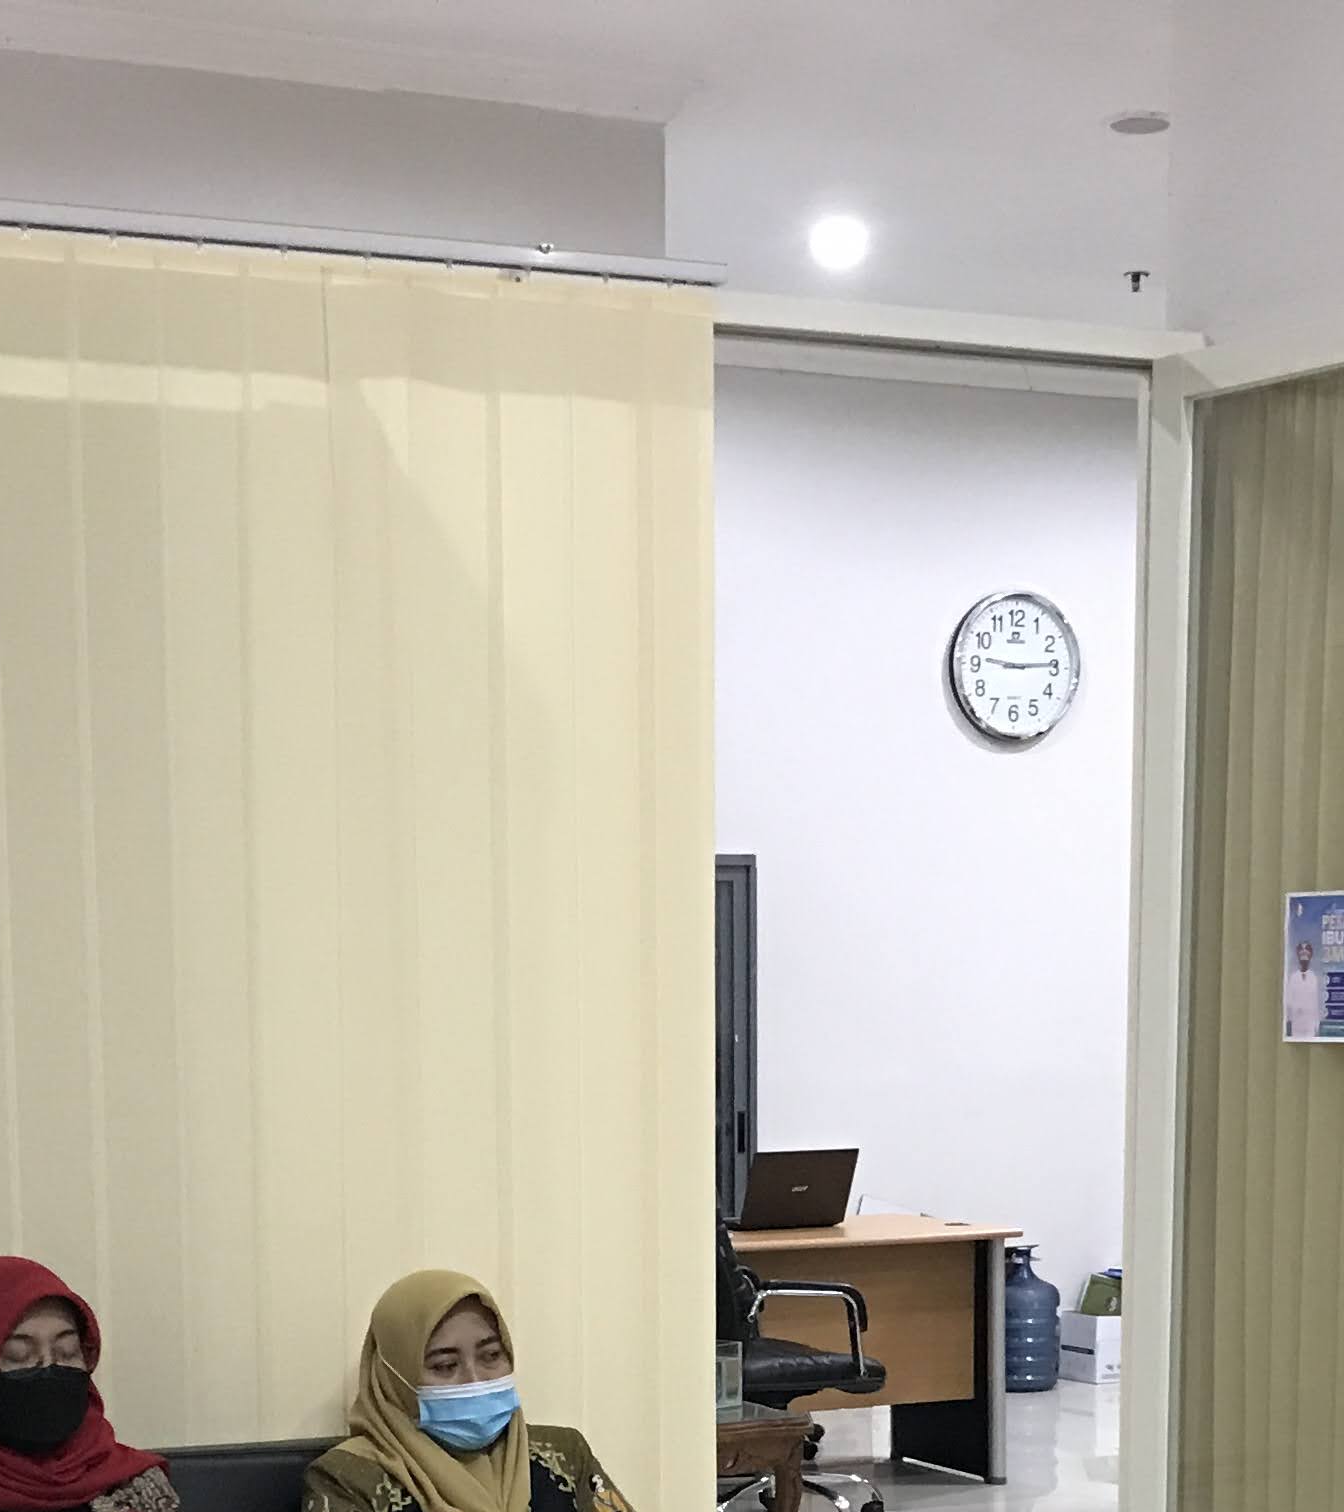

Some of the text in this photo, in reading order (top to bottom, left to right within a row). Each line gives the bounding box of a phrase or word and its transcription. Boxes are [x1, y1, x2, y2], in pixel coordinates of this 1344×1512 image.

[991, 615, 1003, 633] 11
[1008, 609, 1026, 628] 12
[1033, 617, 1040, 634] 1
[976, 631, 992, 650] 10
[1044, 635, 1055, 653] 2
[970, 655, 981, 673] 9
[1048, 659, 1060, 677] 3
[975, 679, 986, 697] 8
[1043, 683, 1053, 699] 4
[990, 698, 1000, 715] 7
[1008, 705, 1019, 722] 6
[1028, 699, 1039, 717] 5
[1322, 930, 1344, 945] IBU
